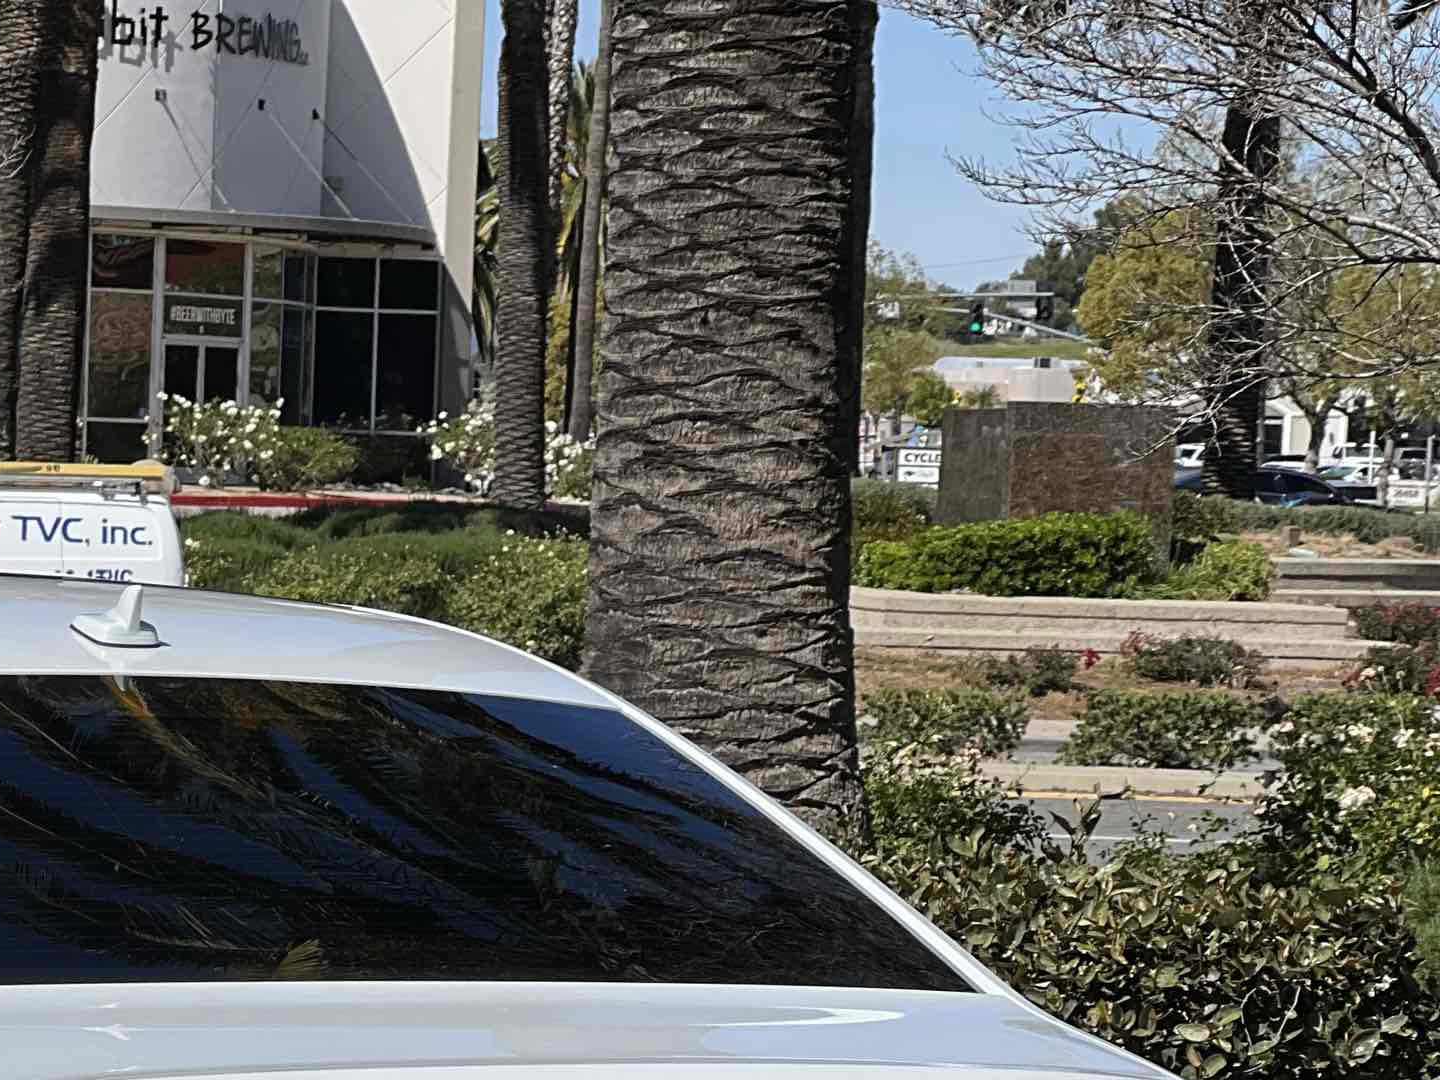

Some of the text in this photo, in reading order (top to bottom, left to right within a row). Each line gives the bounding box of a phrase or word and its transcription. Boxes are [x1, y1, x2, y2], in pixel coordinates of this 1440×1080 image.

[97, 0, 169, 48] bit
[12, 515, 153, 547] TVC, inc.
